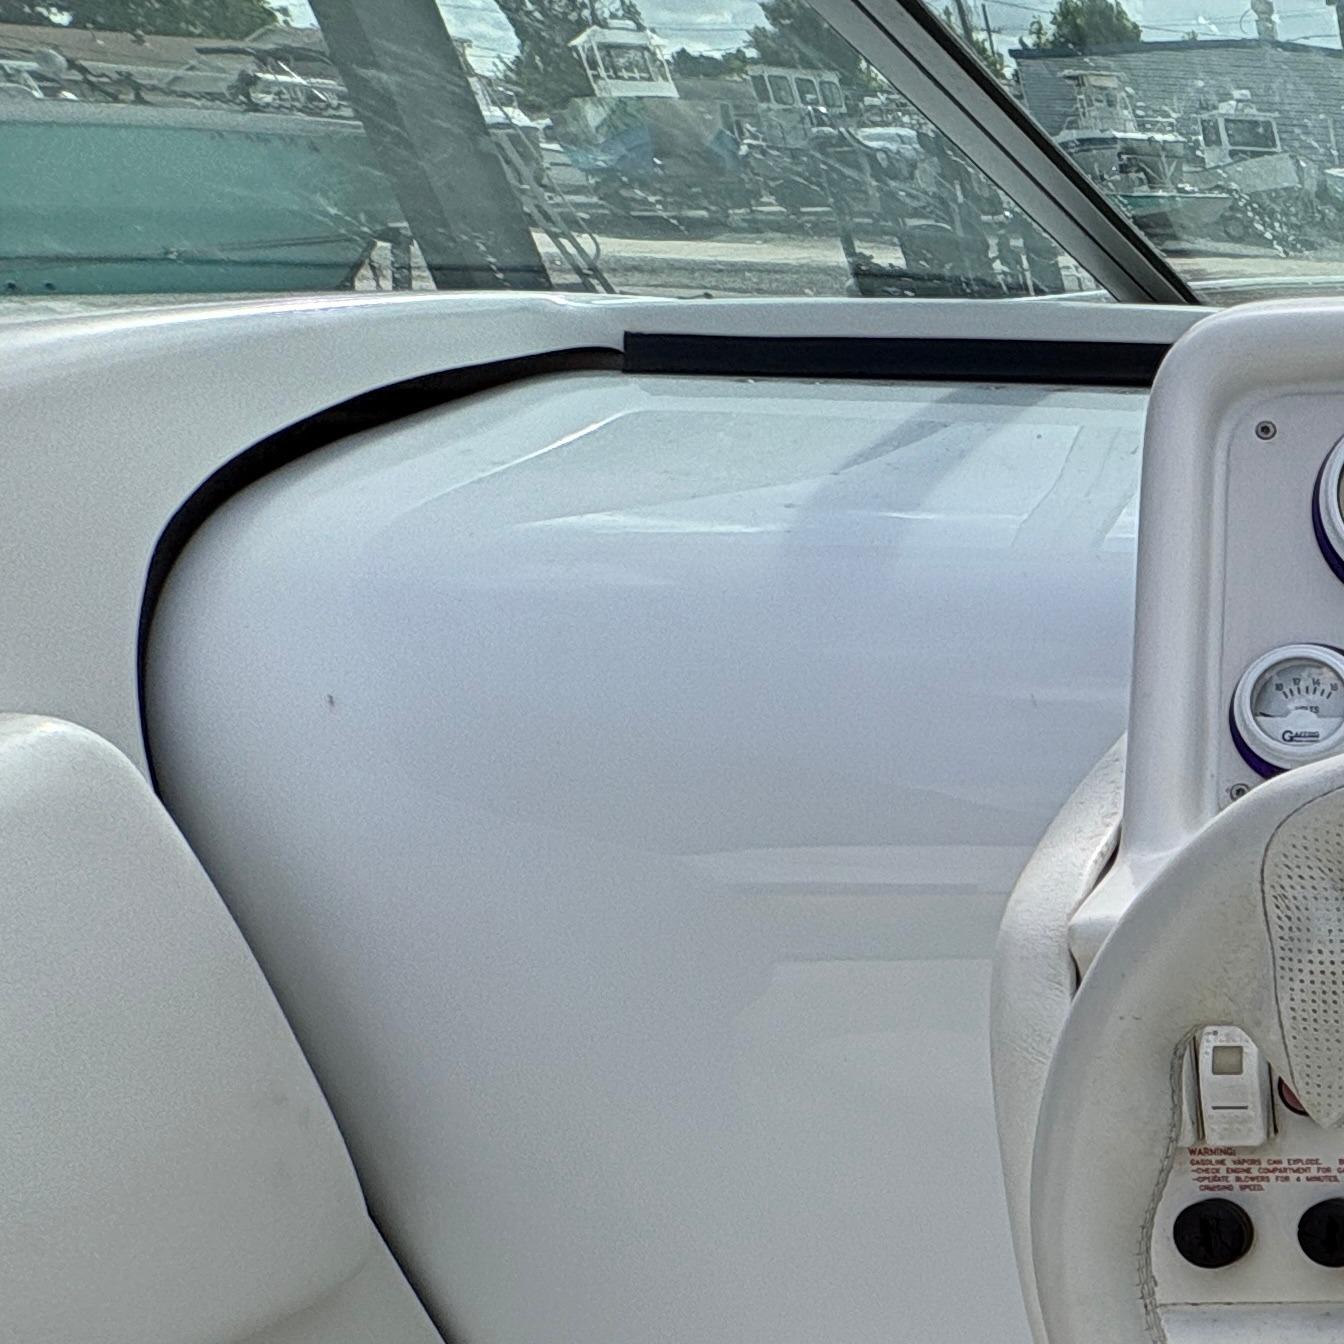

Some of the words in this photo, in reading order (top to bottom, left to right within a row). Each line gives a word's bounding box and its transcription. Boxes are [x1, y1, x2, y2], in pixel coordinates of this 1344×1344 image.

[1275, 683, 1284, 691] 10
[1311, 679, 1320, 687] 14
[1188, 1147, 1236, 1155] WARNING:
